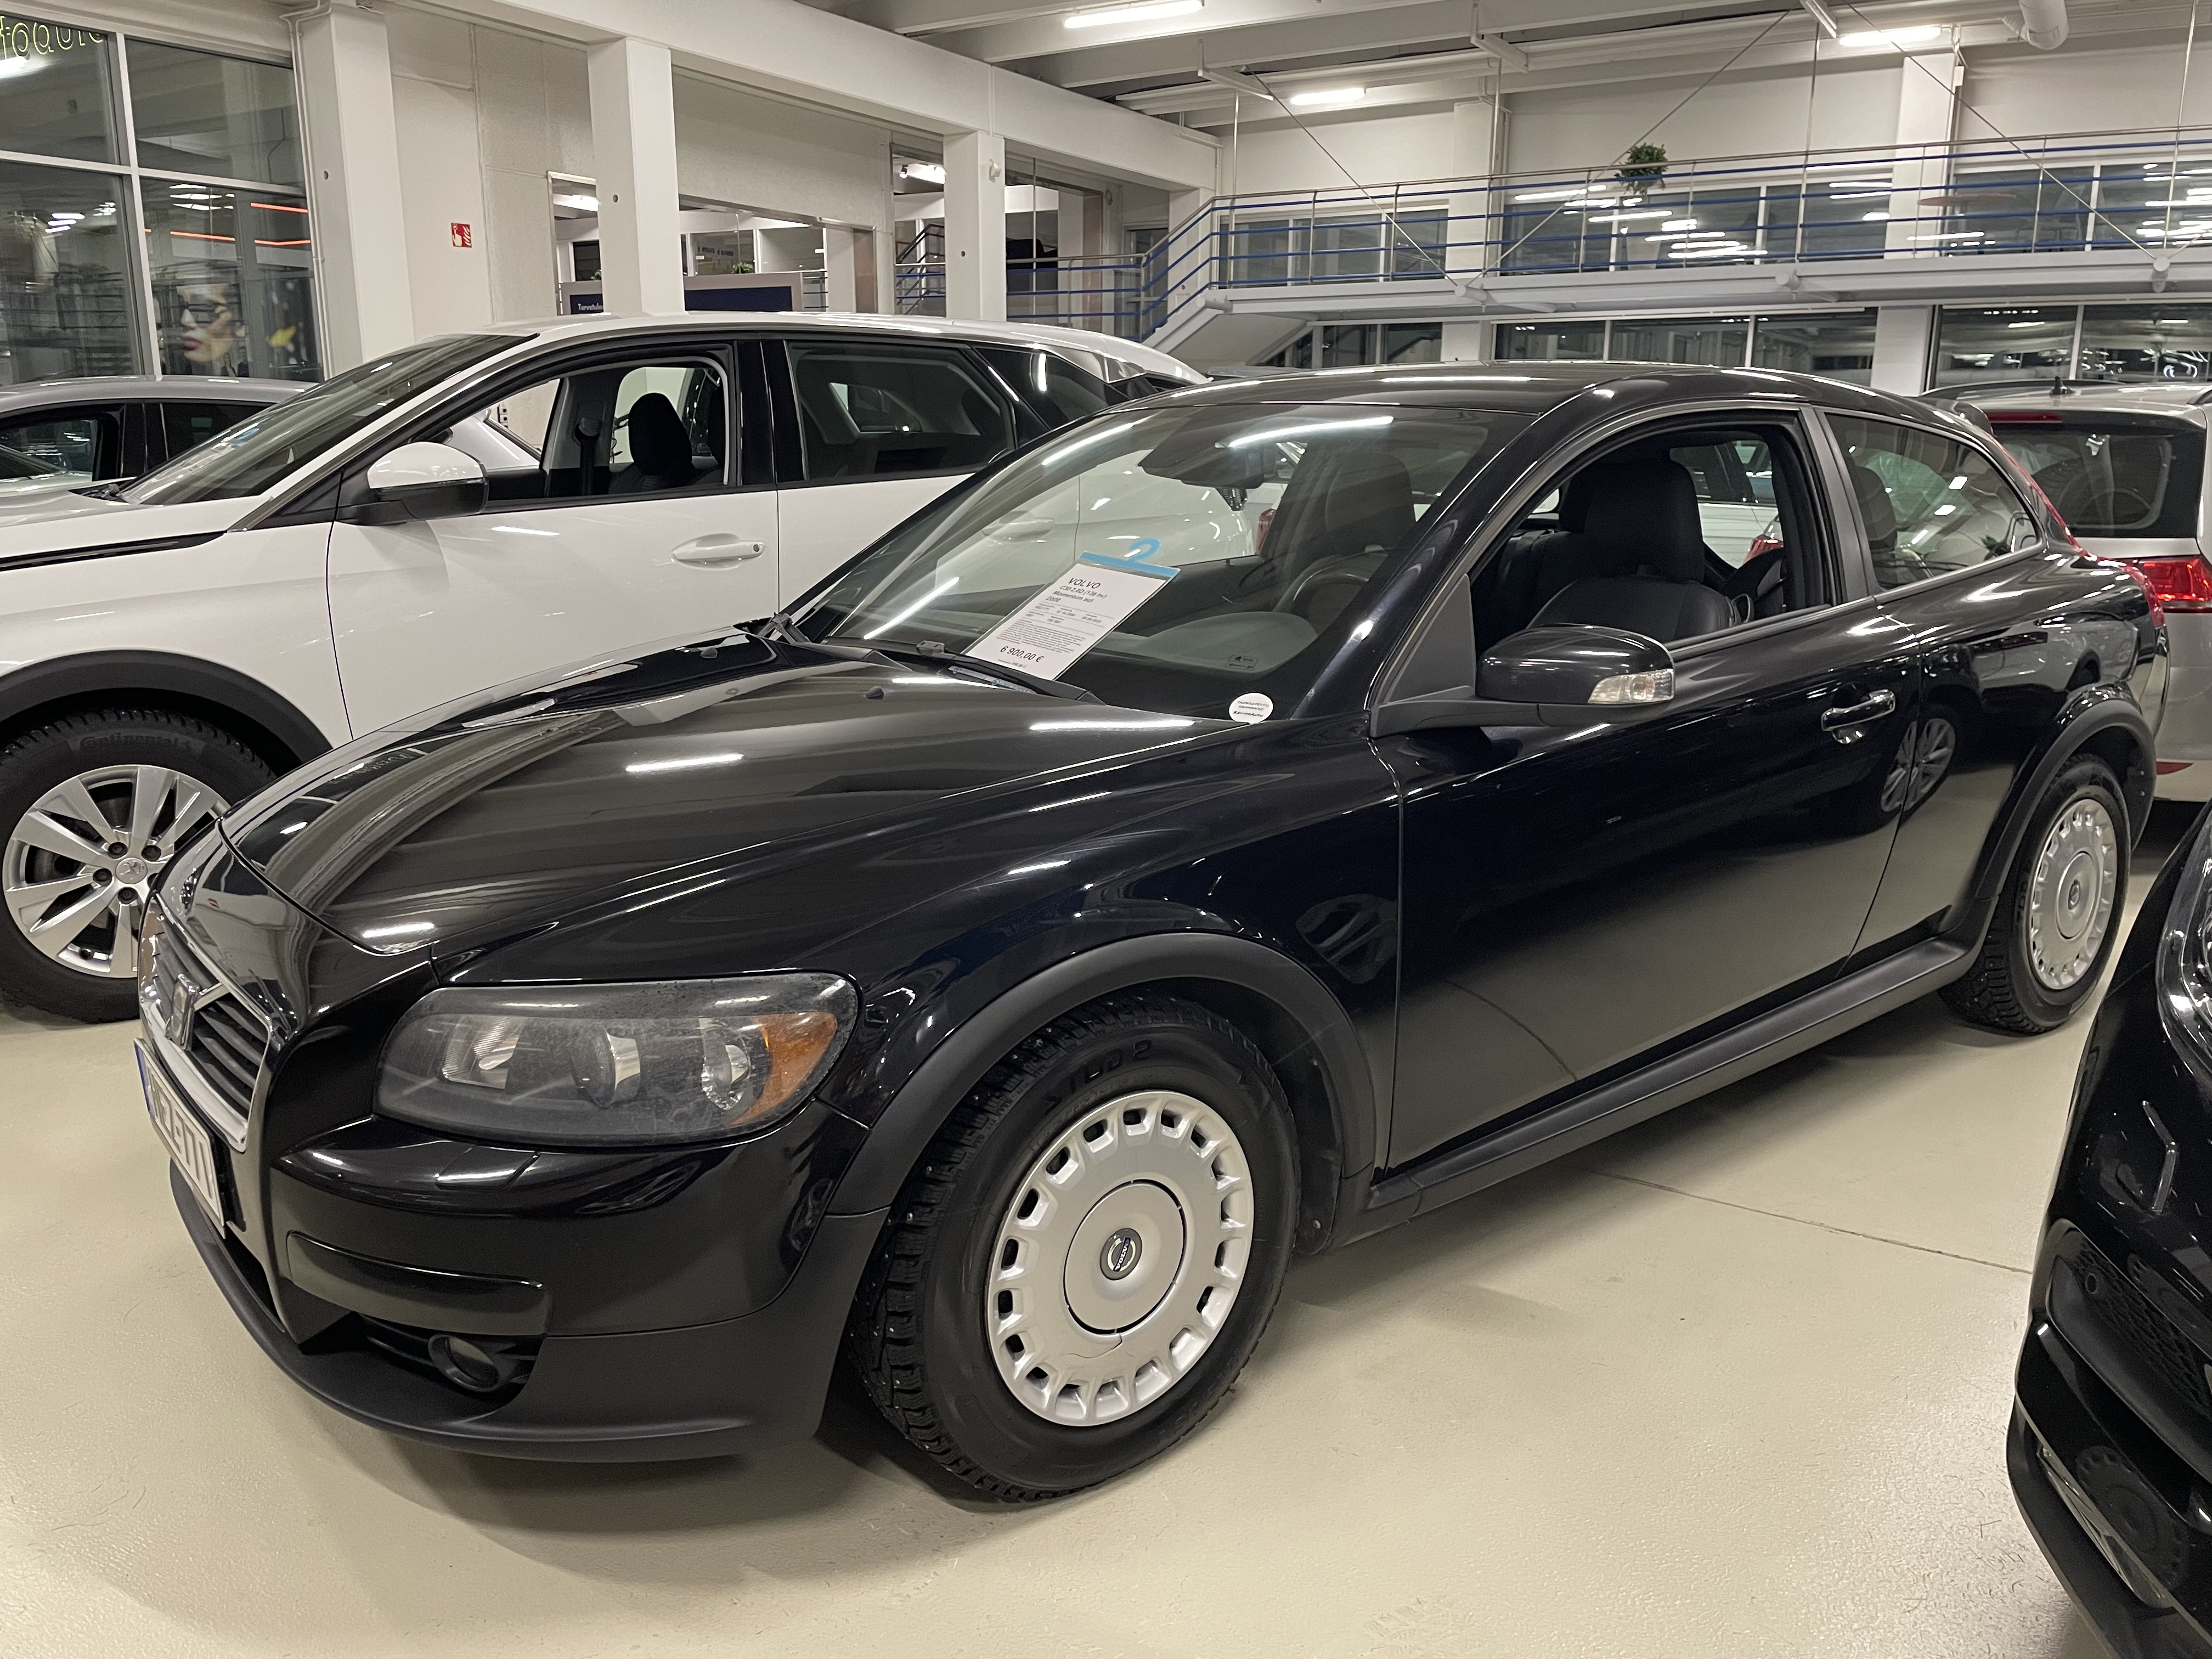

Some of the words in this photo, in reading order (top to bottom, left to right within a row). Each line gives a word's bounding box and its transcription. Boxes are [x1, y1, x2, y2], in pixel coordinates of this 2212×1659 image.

[578, 302, 603, 311] Tervetulo
[1068, 578, 1101, 589] VOLVO
[1052, 590, 1084, 600] Momentum
[1007, 648, 1036, 661] 900,00
[146, 1064, 213, 1200] HEZ-771
[1114, 1238, 1130, 1271] VOLVO
